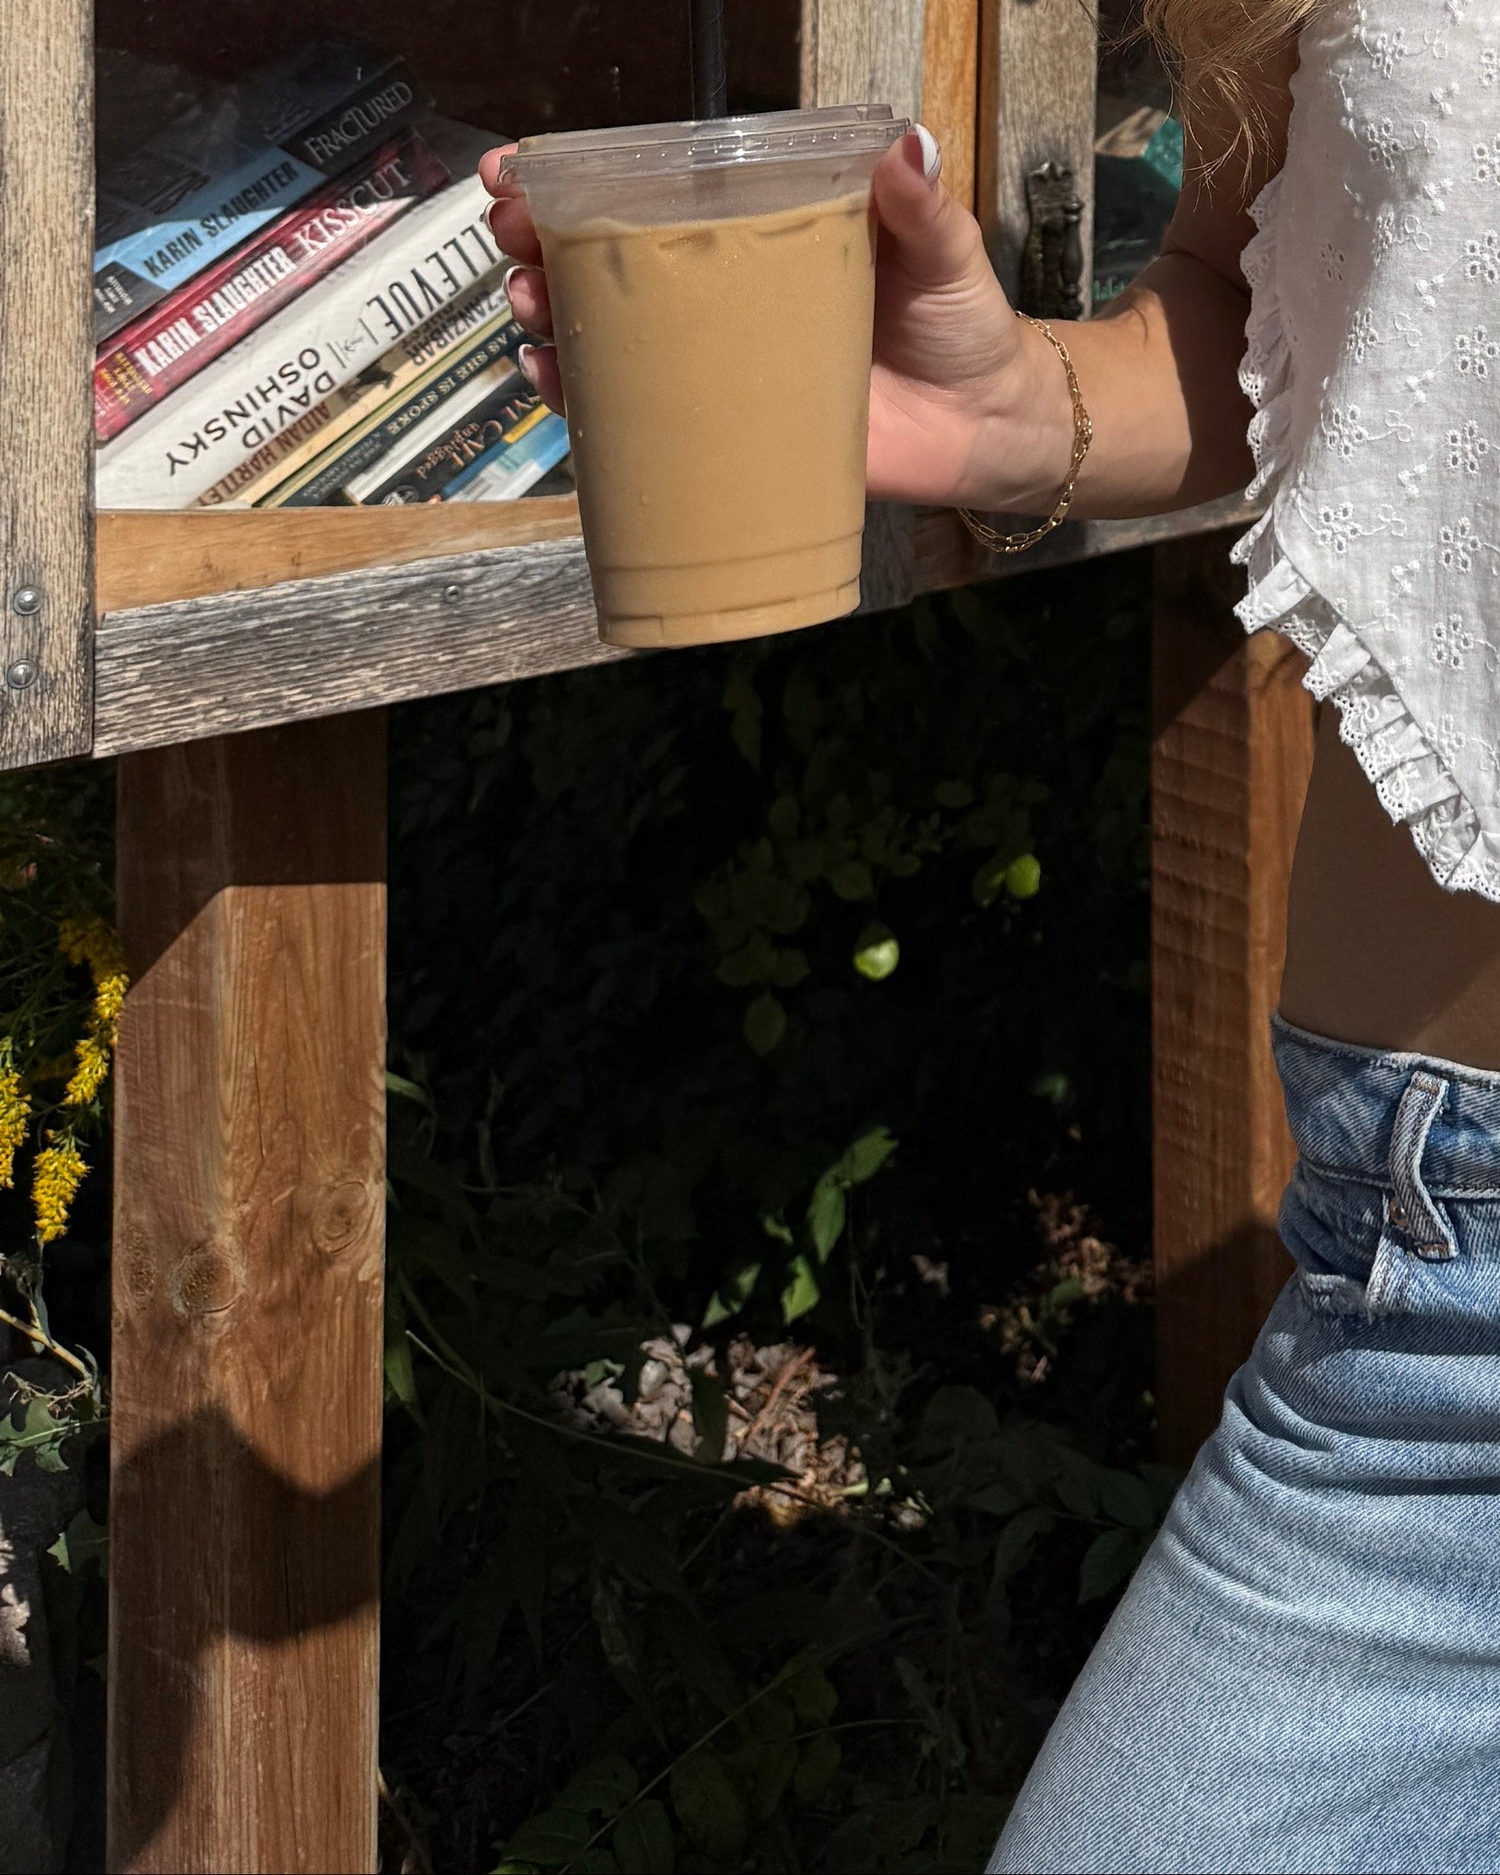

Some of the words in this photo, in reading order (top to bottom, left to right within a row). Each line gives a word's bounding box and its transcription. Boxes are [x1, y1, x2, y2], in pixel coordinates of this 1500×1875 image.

[143, 227, 204, 278] KARIN
[201, 161, 300, 237] SLAUGHTER
[304, 81, 413, 165] FRACTURED
[133, 317, 203, 377] KARIN
[192, 246, 298, 334] SLAUGHTER
[294, 158, 412, 254] KISSCUT
[366, 217, 498, 340] LLEVUE
[406, 290, 499, 366] ZANZIBAR
[488, 333, 508, 355] AS
[438, 376, 457, 394] IS
[455, 352, 489, 381] SHE
[165, 348, 320, 477] OSHINSKY
[242, 371, 337, 448] DAVID
[275, 400, 331, 452] AIDAN
[387, 390, 439, 435] SPOKE
[416, 421, 480, 479] unplugged
